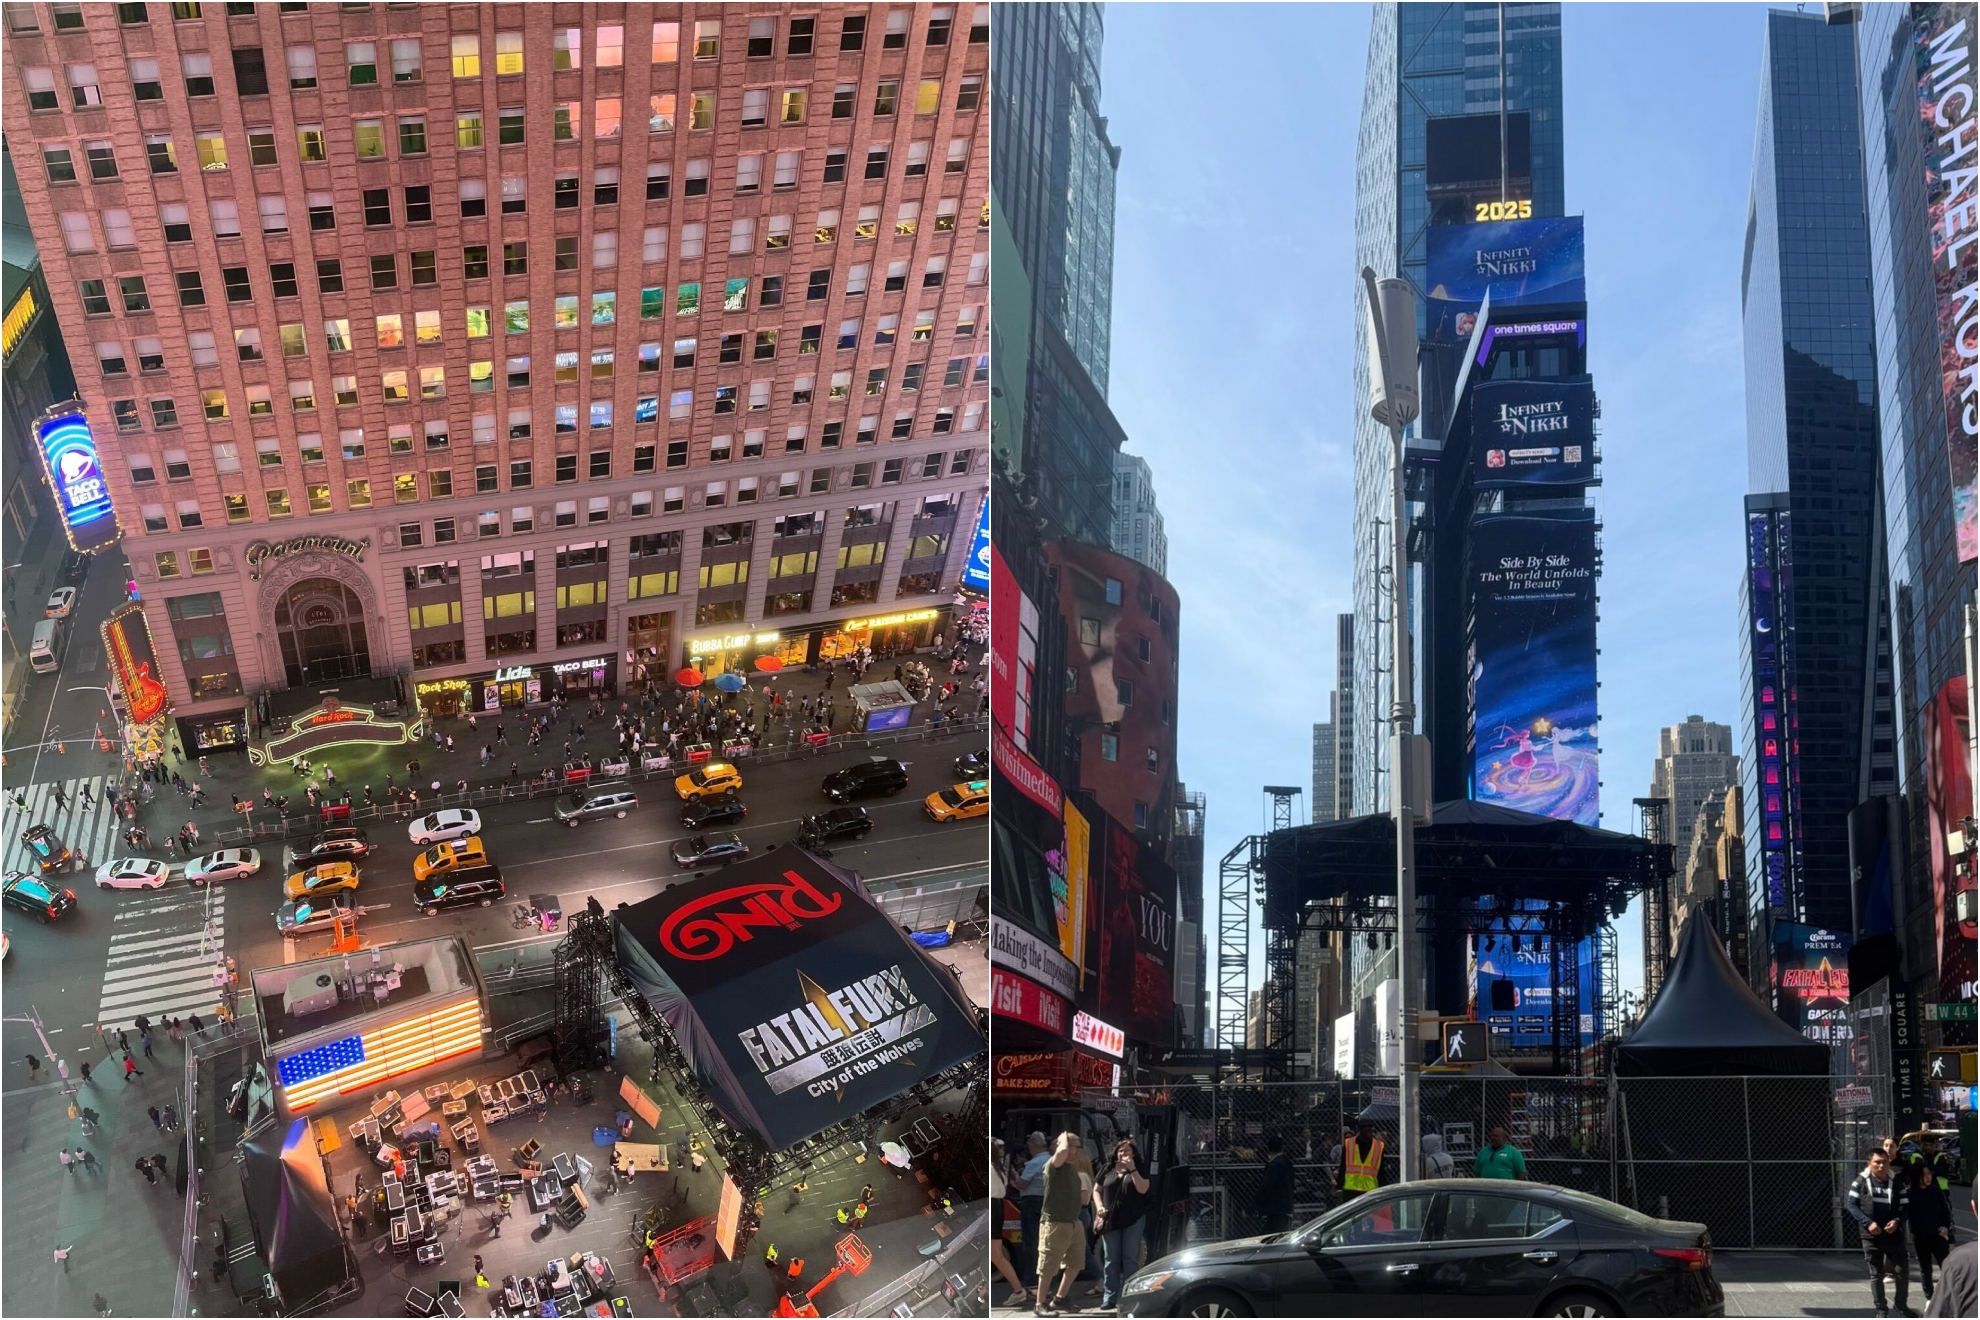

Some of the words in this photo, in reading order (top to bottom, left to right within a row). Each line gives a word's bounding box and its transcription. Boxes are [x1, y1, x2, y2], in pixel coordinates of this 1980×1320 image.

[1929, 18, 1978, 270] MICHAEL
[1475, 200, 1532, 221] 2025
[1476, 247, 1532, 265] INFINITY
[1486, 259, 1537, 277] NIKKI
[1494, 326, 1513, 335] one
[1514, 322, 1541, 334] times
[1543, 321, 1577, 333] square
[1500, 401, 1564, 421] INFINITY
[1513, 415, 1569, 435] NIKKI
[64, 478, 101, 497] TACO
[70, 488, 105, 508] BELL
[245, 535, 370, 582] Paramount
[1499, 557, 1524, 569] Side
[1526, 556, 1544, 570] By
[1545, 555, 1570, 567] Side
[1480, 572, 1501, 582] The
[1505, 570, 1540, 581] World
[1544, 567, 1590, 579] Unfolds
[1508, 581, 1520, 590] In
[1524, 580, 1563, 590] Beauty
[692, 638, 722, 654] BUBBA
[495, 665, 532, 682] Lids
[553, 662, 580, 674] TACO
[581, 658, 607, 669] BELL
[418, 682, 441, 694] Rock
[443, 680, 467, 690] Shop
[312, 711, 333, 724] Hard
[333, 710, 354, 721] Rock
[659, 870, 842, 961] RING
[1140, 894, 1172, 952] YOU
[785, 920, 804, 932] THE
[1809, 933, 1836, 942] Corona
[1028, 940, 1042, 971] the
[1782, 969, 1828, 987] FATAL
[738, 1001, 844, 1073] FATAL
[827, 964, 918, 1031] FURY
[1038, 990, 1061, 1031] iVisit
[1895, 992, 1908, 1045] SQUARE
[1939, 1006, 1949, 1018] W
[1954, 1006, 1969, 1018] 44
[819, 1027, 887, 1069] 餓狼伝説
[807, 1076, 840, 1099] City
[838, 1068, 853, 1084] of
[852, 1059, 878, 1077] the
[876, 1035, 924, 1066] Wolves
[996, 1078, 1023, 1088] BAKE
[1023, 1079, 1051, 1089] SHOP
[1899, 1058, 1911, 1099] TIMES
[1836, 1088, 1871, 1098] NATIONAL
